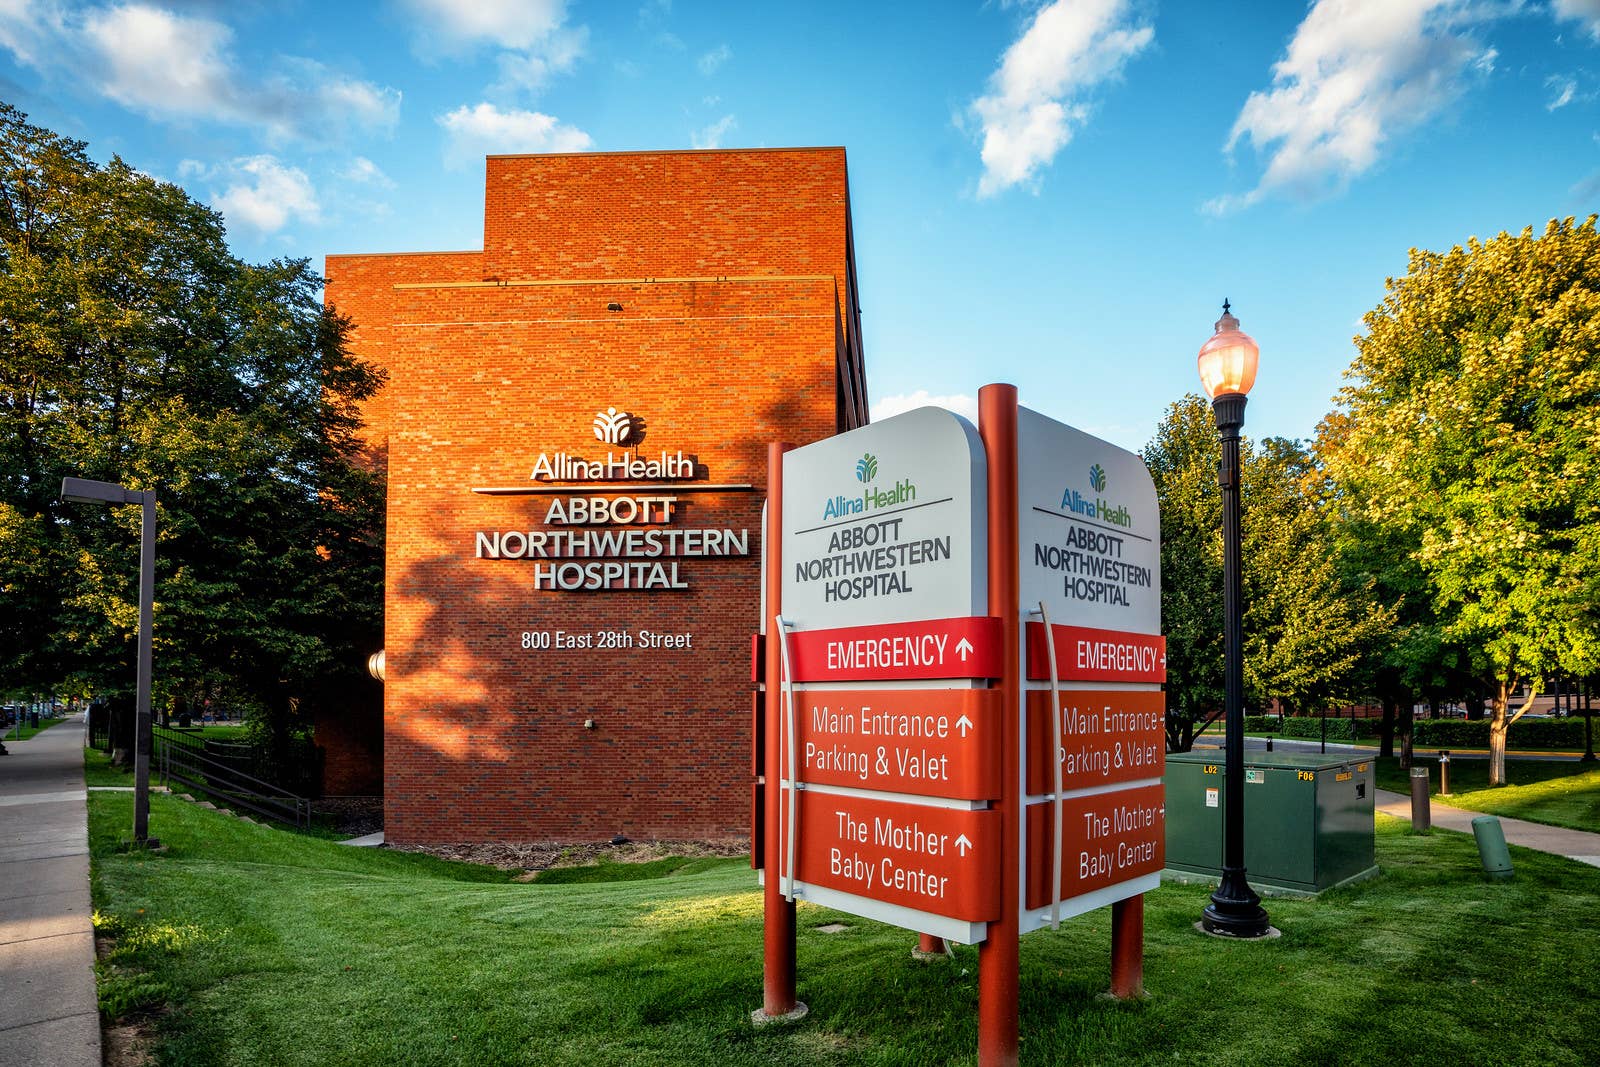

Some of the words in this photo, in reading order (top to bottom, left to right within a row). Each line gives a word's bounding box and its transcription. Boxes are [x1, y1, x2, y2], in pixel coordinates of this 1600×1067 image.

[530, 452, 603, 480] Allina
[608, 451, 693, 479] Health
[544, 496, 677, 524] ABBOTT
[823, 495, 863, 521] Allina
[864, 478, 916, 511] Health
[1061, 487, 1096, 519] Allina
[1096, 497, 1132, 529] Health
[475, 528, 748, 559] NORTHWESTERN
[828, 517, 903, 553] ABBOTT
[1066, 525, 1123, 558] ABBOTT
[796, 535, 951, 583] NORTHWESTERN
[1034, 543, 1151, 588] NORTHWESTERN
[534, 562, 689, 591] HOSPITAL
[825, 570, 912, 602] HOSPITAL
[1064, 575, 1130, 607] HOSPITAL
[521, 632, 550, 649] 800
[556, 632, 593, 648] East
[597, 631, 632, 648] 28th
[638, 630, 692, 648] Street
[827, 634, 948, 670] EMERGENCY
[1077, 640, 1157, 672] EMERGENCY
[812, 706, 854, 734] Main
[861, 706, 949, 738] Entrance
[1063, 707, 1099, 735] Main
[1103, 706, 1158, 733] Entrance
[806, 742, 868, 780] Parking
[875, 745, 890, 776] &
[895, 747, 948, 781] Valet
[1113, 741, 1124, 768] &
[1127, 740, 1157, 767] Valet
[1298, 771, 1314, 781] F06
[836, 811, 868, 842] The
[874, 816, 948, 857] Mother
[1084, 812, 1109, 840] The
[1113, 804, 1157, 833] Mother
[831, 848, 875, 889] Baby
[881, 857, 948, 898] Center
[1080, 847, 1114, 880] Baby
[1117, 839, 1157, 869] Center
